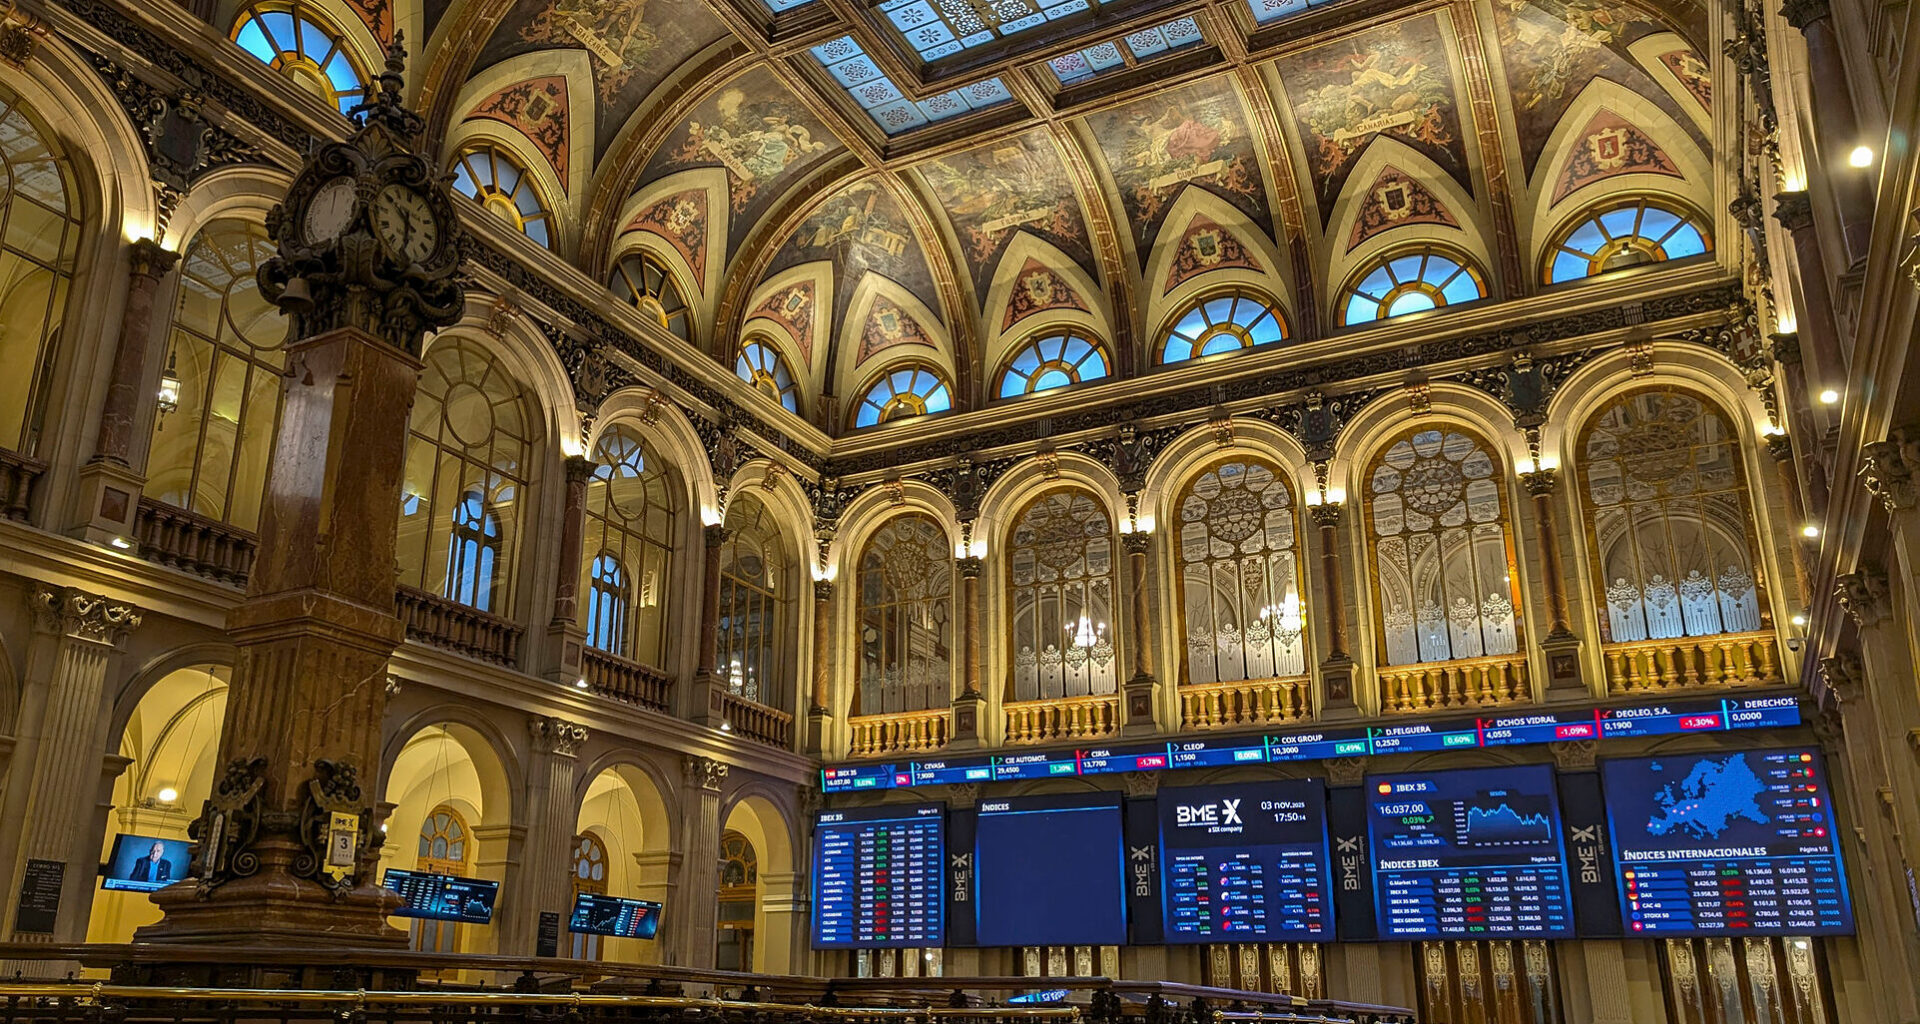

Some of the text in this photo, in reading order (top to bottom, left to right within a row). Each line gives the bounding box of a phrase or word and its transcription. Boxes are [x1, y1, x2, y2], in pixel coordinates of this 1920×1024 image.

[575, 27, 609, 57] BALEARES
[1745, 698, 1794, 709] DERECHOS
[1654, 707, 1671, 716] S.A.
[1497, 715, 1557, 727] DCHOS VIDRAL
[1733, 712, 1762, 722] 0,0000
[1604, 721, 1632, 730] 0,1900
[1685, 717, 1714, 727] -1,30%
[1386, 725, 1431, 736] D.FELGUERA
[1486, 730, 1512, 739] 4,0555
[1560, 726, 1588, 736] -1,09%
[1281, 734, 1323, 744] COX GROUP
[1376, 738, 1400, 748] 0,2520
[1447, 735, 1470, 744] 0,60%
[1183, 743, 1204, 751] CLEOP
[1272, 747, 1299, 755] 10,3000
[1339, 744, 1361, 752] 0,49%
[1091, 750, 1110, 758] CIRSA
[1175, 754, 1196, 762] 1,1500
[1016, 755, 1047, 764] AUTOMOT.
[1083, 760, 1107, 768] 13,7700
[1140, 758, 1162, 766] -1,78%
[924, 762, 945, 770] CEVASA
[1396, 783, 1427, 792] IBEX 35
[982, 803, 1010, 812] ÍNDICES
[1261, 801, 1272, 810] 03
[1380, 804, 1424, 814] 16.037,00
[1176, 804, 1219, 823] BME
[1402, 816, 1425, 824] 0,03%
[1220, 826, 1243, 834] company
[340, 838, 348, 849] 3
[1624, 847, 1767, 860] ÍNDICES INTERNACIONALES
[1380, 859, 1439, 869] ÍNDICES IBEX
[1578, 846, 1597, 884] BME
[1341, 855, 1358, 891] BME
[1135, 864, 1148, 896] BME
[955, 871, 966, 901] BME
